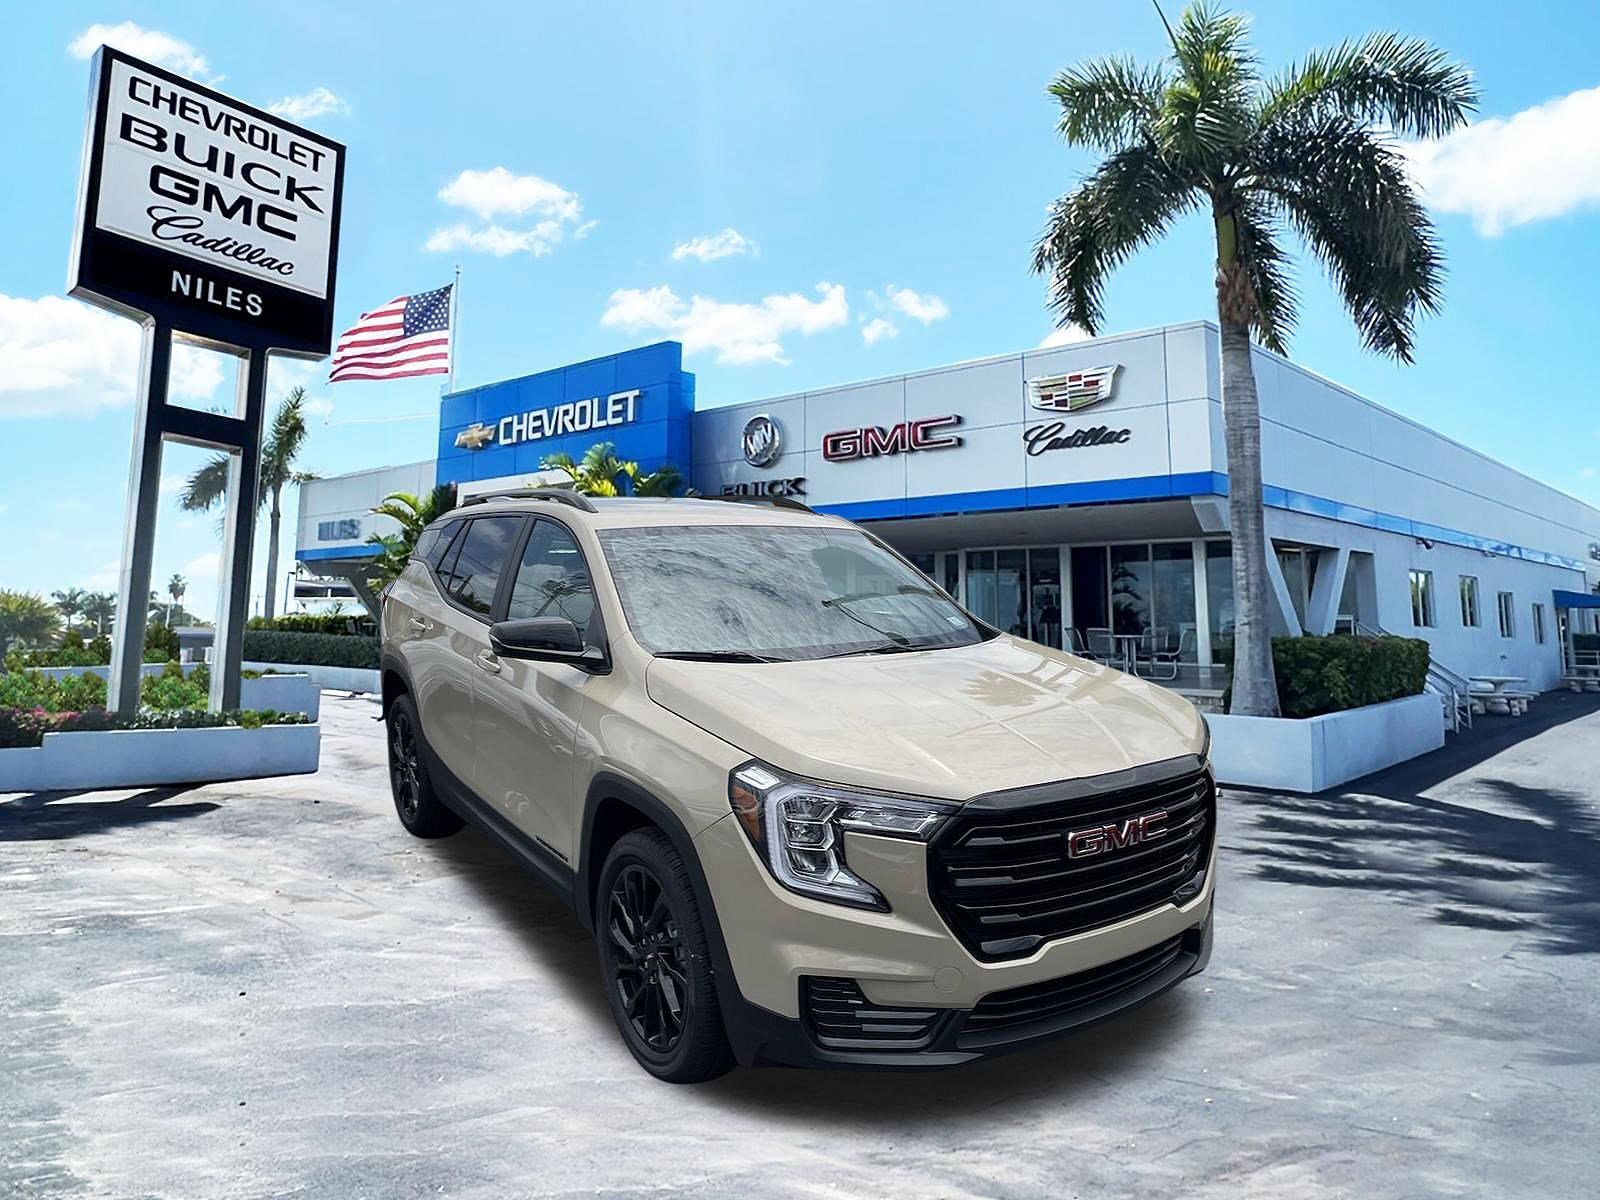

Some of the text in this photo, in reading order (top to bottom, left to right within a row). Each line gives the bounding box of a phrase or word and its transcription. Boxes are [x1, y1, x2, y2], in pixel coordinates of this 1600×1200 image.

[128, 76, 326, 173] CHEVROLET
[120, 112, 325, 214] BUICK
[150, 164, 298, 242] GMC
[146, 205, 294, 276] Cadillac
[171, 270, 263, 316] NILES
[498, 389, 640, 446] CHEVROLET
[822, 414, 962, 462] GMC
[1023, 422, 1131, 457] Cadillac
[1067, 811, 1168, 859] GMC
